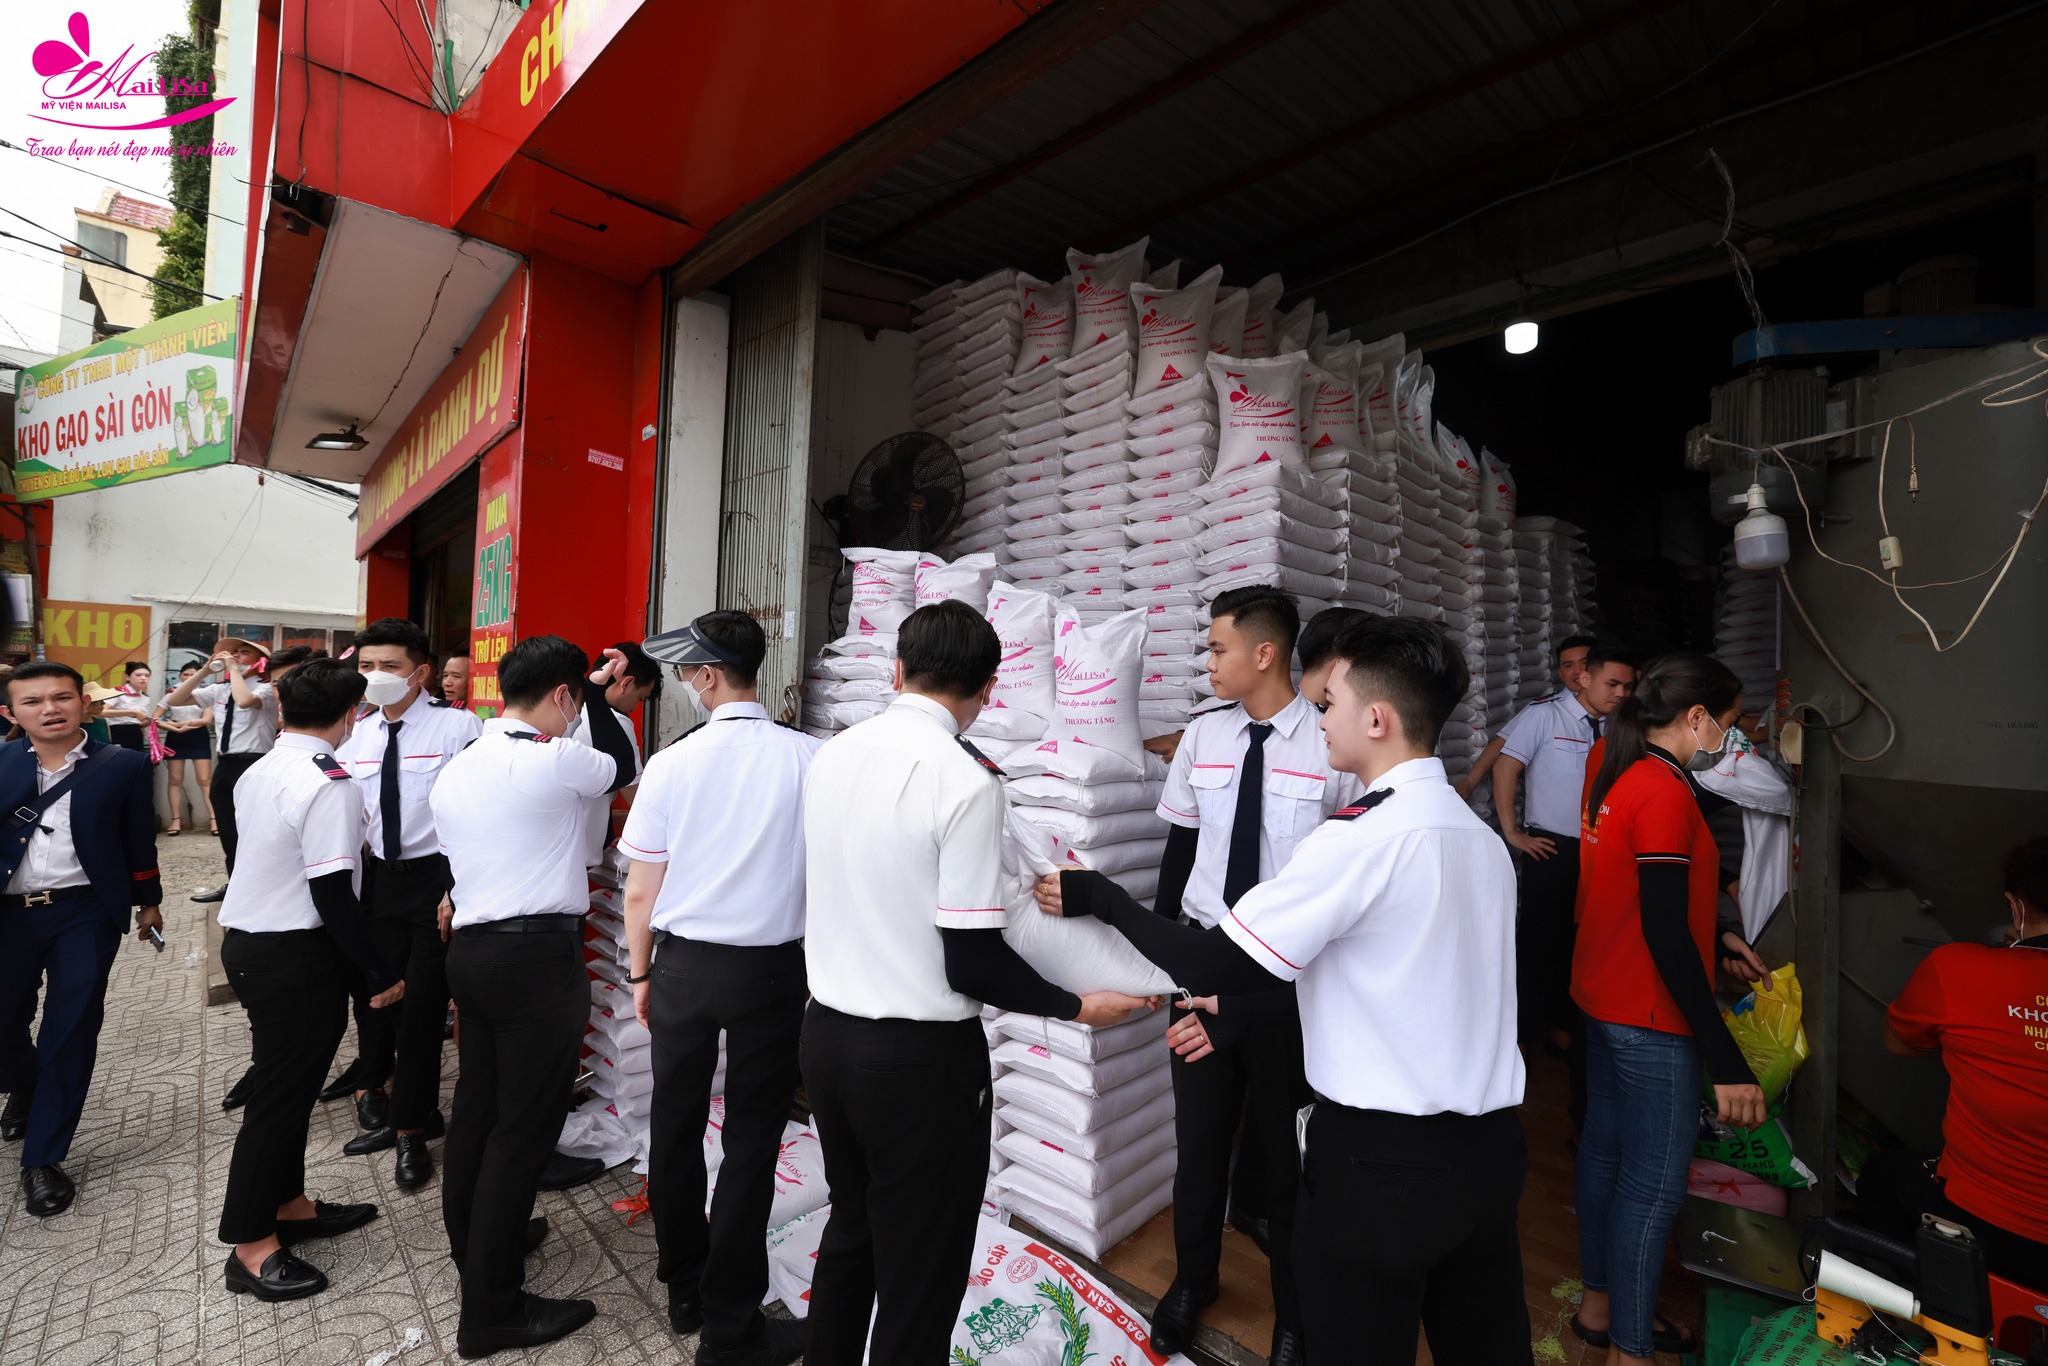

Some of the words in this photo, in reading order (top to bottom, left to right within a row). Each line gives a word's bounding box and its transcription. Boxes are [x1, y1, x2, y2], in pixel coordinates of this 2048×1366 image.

[37, 372, 64, 399] CÔNG
[66, 368, 80, 390] TY
[82, 358, 112, 385] TNHH
[116, 346, 141, 376] MỘT
[144, 332, 187, 365] THÀNH
[192, 318, 228, 351] VIÊN
[408, 415, 426, 489] LÀ
[427, 367, 473, 472] DANH
[475, 314, 509, 425] DỰ
[18, 421, 50, 461] KHO
[56, 410, 88, 457] GẠO
[95, 392, 124, 442] SÀI
[132, 380, 171, 433] GÒN
[82, 461, 96, 481] CÁC
[97, 461, 114, 480] LOẠI
[116, 460, 131, 476] GẠO
[485, 492, 507, 534] MUA
[475, 532, 512, 630] 25KG
[43, 608, 143, 650] KHO
[475, 630, 490, 664] TRỞ
[490, 632, 507, 664] LÊN
[1094, 716, 1114, 726] TẶNG
[1729, 1140, 1769, 1160] 25
[1047, 1254, 1067, 1268] 21
[1067, 1272, 1086, 1290] ST
[1087, 1290, 1116, 1314] SẢN
